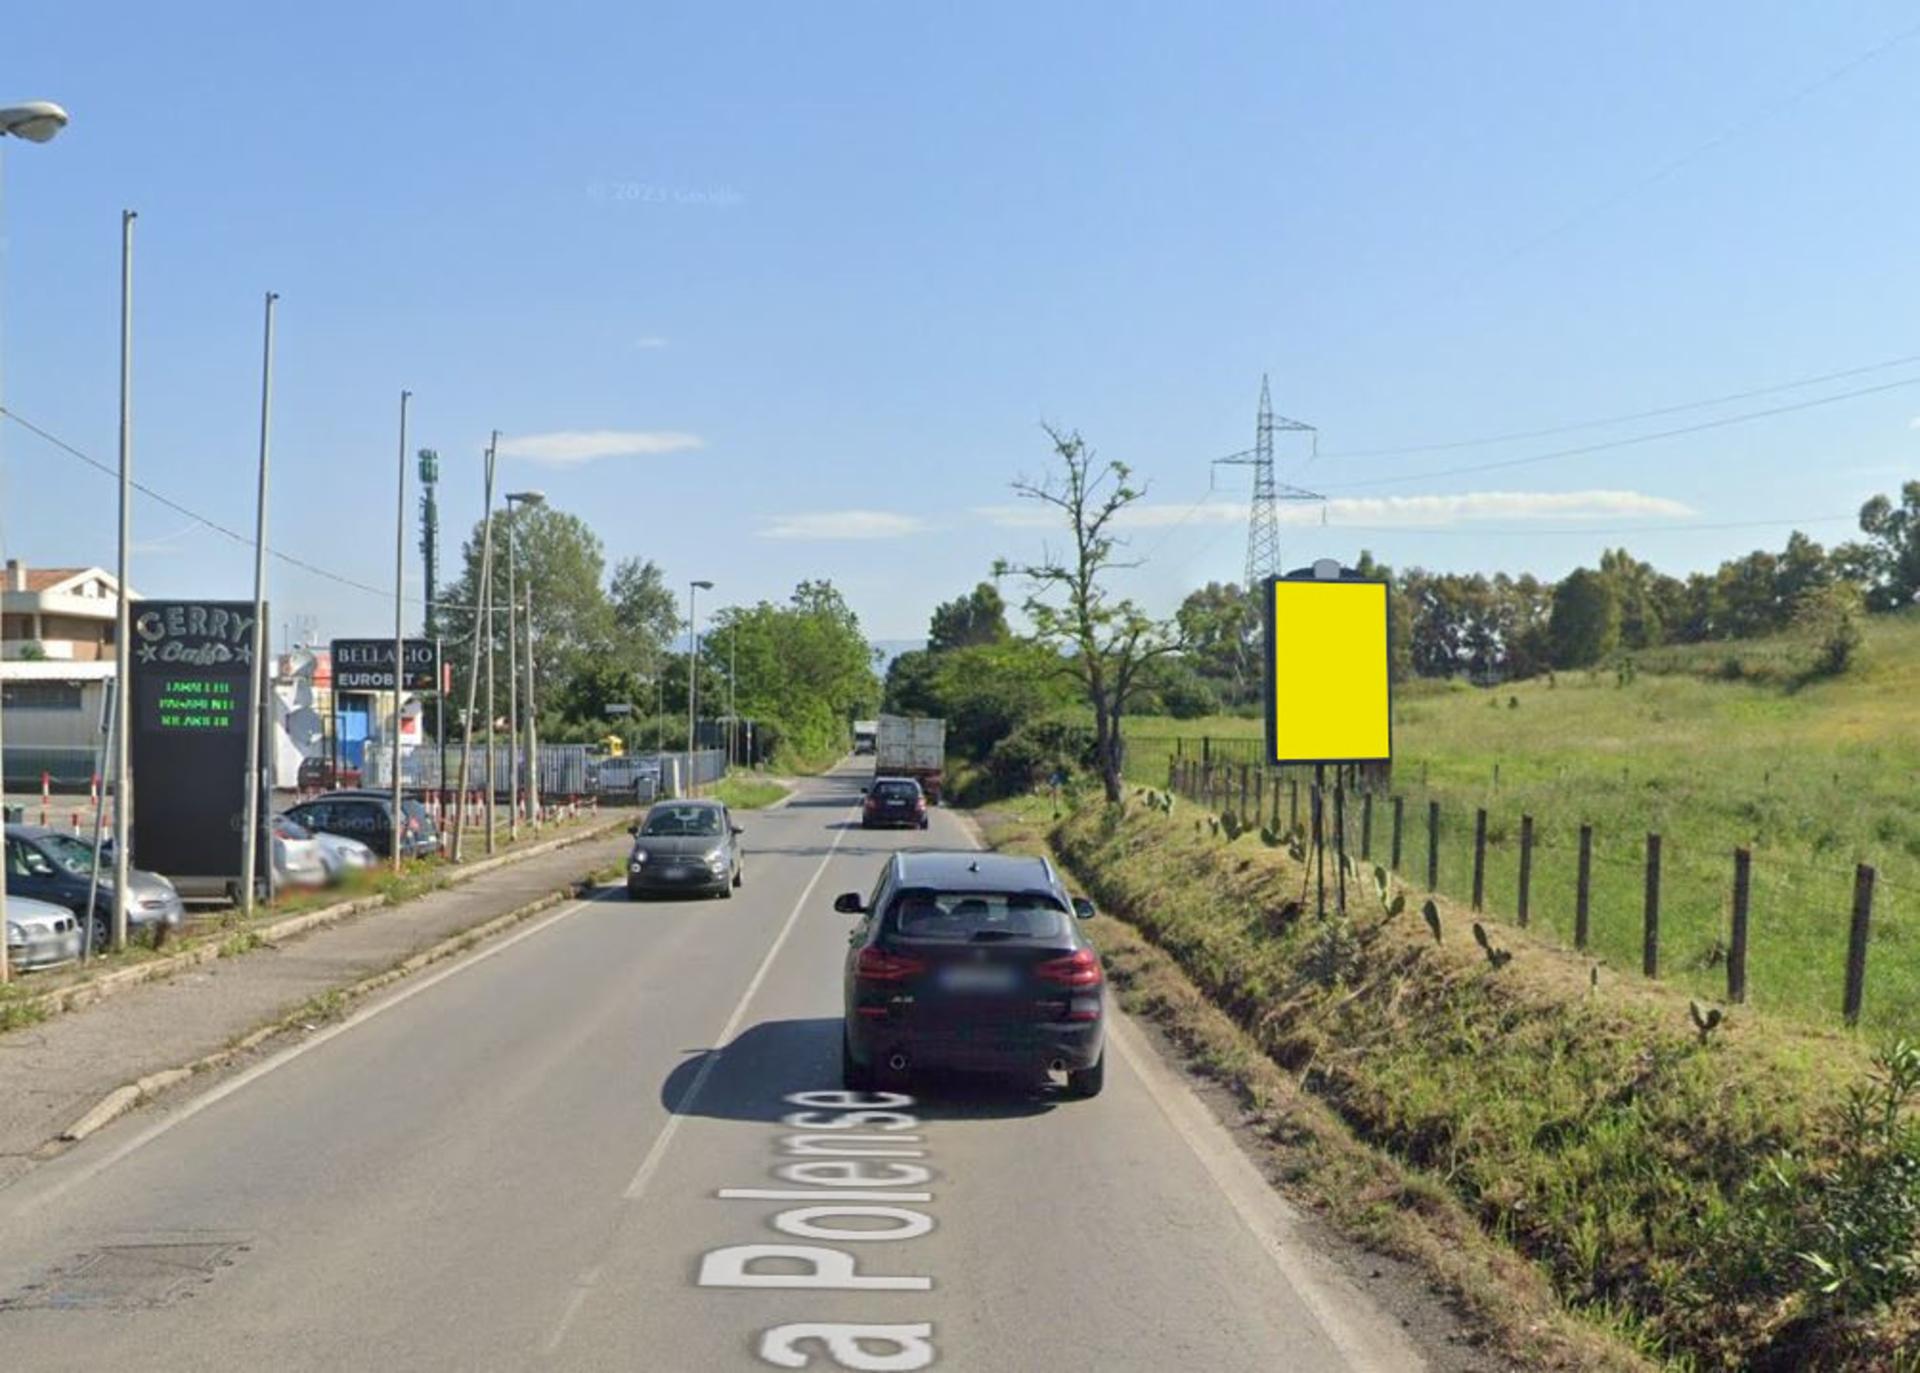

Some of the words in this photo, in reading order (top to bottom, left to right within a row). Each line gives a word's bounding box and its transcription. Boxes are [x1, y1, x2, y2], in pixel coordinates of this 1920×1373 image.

[137, 605, 254, 643] GERRY
[338, 647, 433, 663] BELLAIO
[338, 672, 415, 687] EUROBT
